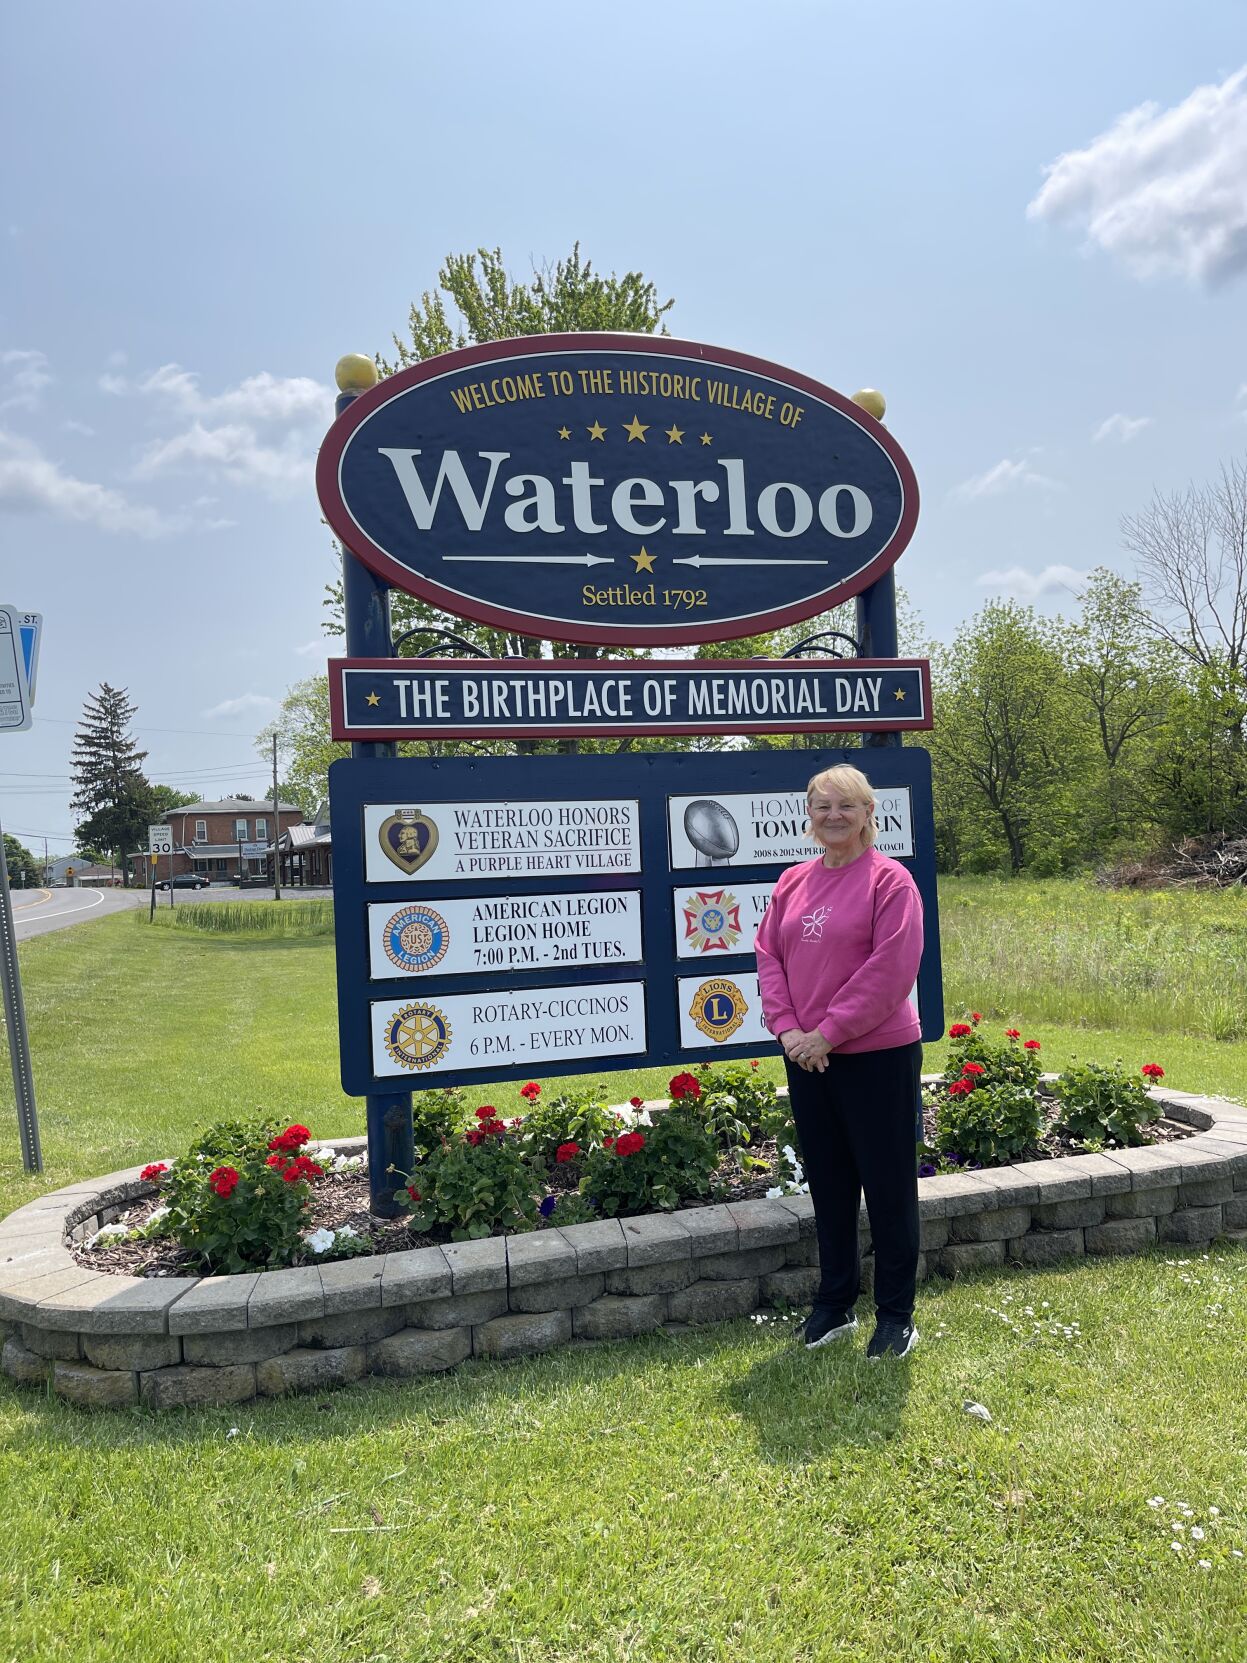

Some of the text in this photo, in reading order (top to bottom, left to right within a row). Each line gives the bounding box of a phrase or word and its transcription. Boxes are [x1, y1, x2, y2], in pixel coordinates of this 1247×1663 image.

[450, 369, 805, 429] WELCOME TO THE HISTORIC VILLAGE OF
[378, 447, 873, 539] Waterloo
[582, 584, 708, 611] Settled 1792
[393, 677, 883, 719] THE BIRTHPLACE OF MEMORIAL DAY
[882, 798, 902, 812] OF
[454, 806, 631, 828] WATERLOO HONORS
[454, 827, 632, 850] VETERAN SACRIFICE
[751, 819, 797, 838] TOM
[152, 843, 171, 853] 30
[753, 849, 772, 858] 2008
[773, 849, 779, 857] &
[779, 848, 795, 857] 2012
[795, 847, 819, 856] SUPER
[880, 842, 904, 852] COACH
[455, 852, 633, 872] A PURPLE HEART VILLAGE
[472, 897, 628, 921] AMERICAN LEGION
[393, 914, 440, 937] AMERICAN
[473, 920, 592, 943] LEGION HOME
[410, 934, 423, 945] US
[397, 949, 436, 964] LEGION
[474, 948, 505, 966] 7:00
[508, 946, 540, 964] P.M.
[553, 943, 578, 961] 2nd
[581, 940, 626, 959] TUES.
[703, 982, 733, 994] LIONS
[403, 1009, 433, 1019] ROTARY
[472, 996, 630, 1023] ROTARY-CICCINOS
[710, 998, 728, 1021] L
[470, 1038, 479, 1055] 6
[482, 1036, 515, 1054] P.M.
[530, 1028, 586, 1051] EVERY
[590, 1024, 634, 1046] MON.
[702, 1021, 740, 1036] INTERNATIONAL
[394, 1044, 444, 1064] INTERNATIONAL
